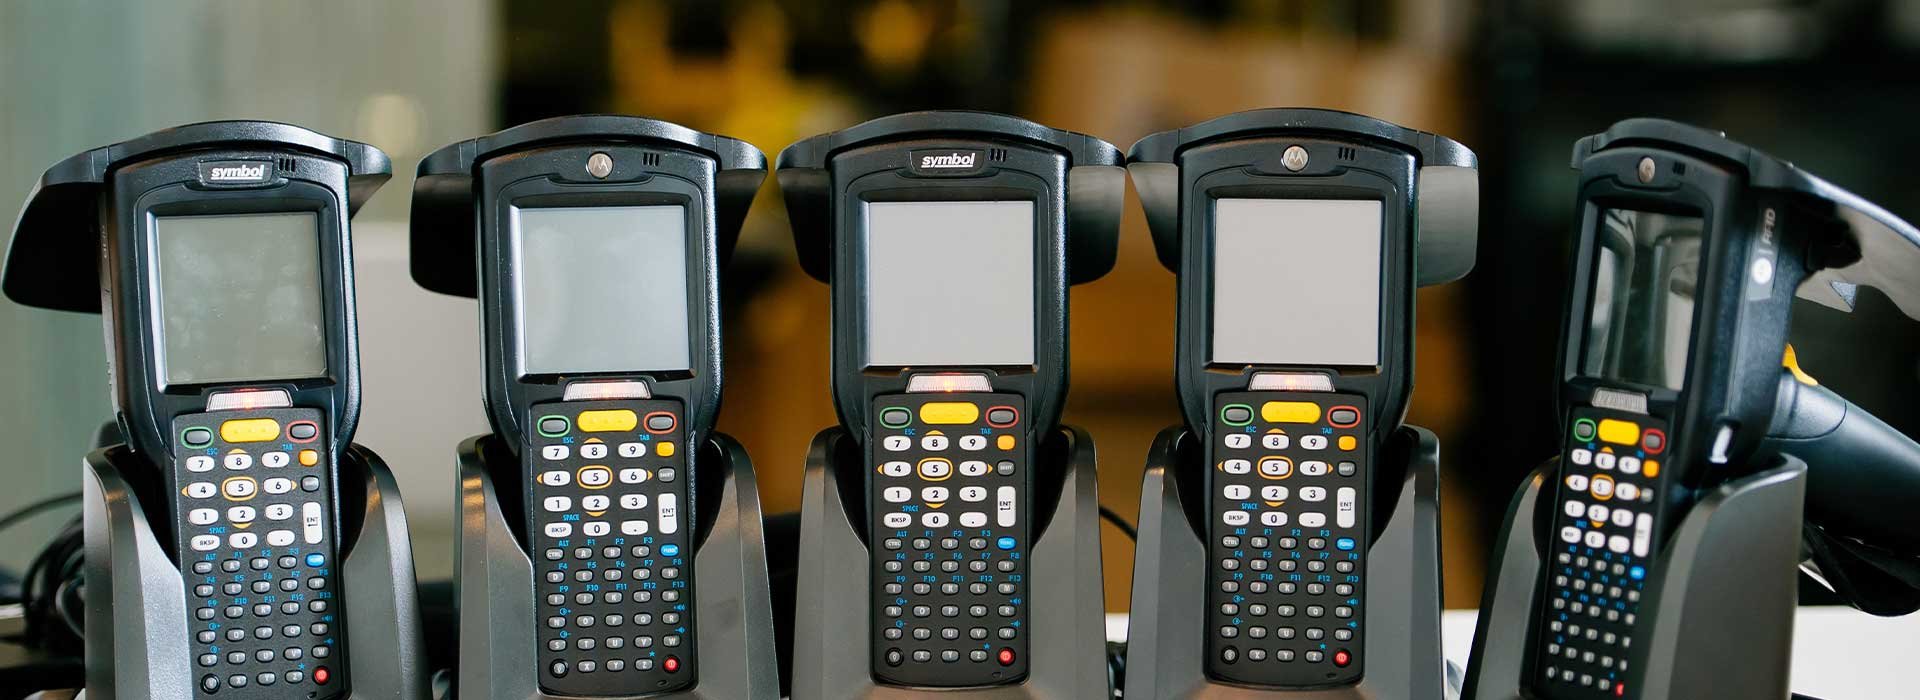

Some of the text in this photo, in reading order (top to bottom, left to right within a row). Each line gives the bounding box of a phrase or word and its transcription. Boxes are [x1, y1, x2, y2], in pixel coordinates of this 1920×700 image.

[921, 153, 975, 168] symbol
[211, 164, 264, 179] symbol
[1762, 208, 1776, 245] RFID
[932, 439, 938, 447] 8
[970, 439, 976, 447] 9
[1234, 437, 1316, 447] 7 8 9
[553, 446, 636, 457] 7 8 9
[932, 464, 938, 472] 5
[970, 464, 976, 472] 6
[1234, 463, 1316, 472] 4 5 6
[593, 473, 598, 482] 5
[631, 472, 637, 480] 6
[200, 486, 206, 494] 4
[275, 482, 281, 490] 6
[1234, 488, 1316, 498] 1 2 3
[933, 490, 938, 498] 2
[970, 490, 976, 498] 3
[556, 498, 638, 508] 1 2 3
[203, 508, 283, 520] 1 2 3
[1270, 515, 1277, 523] 0
[933, 516, 938, 524] 0
[594, 525, 600, 533] 0
[242, 536, 248, 544] 0
